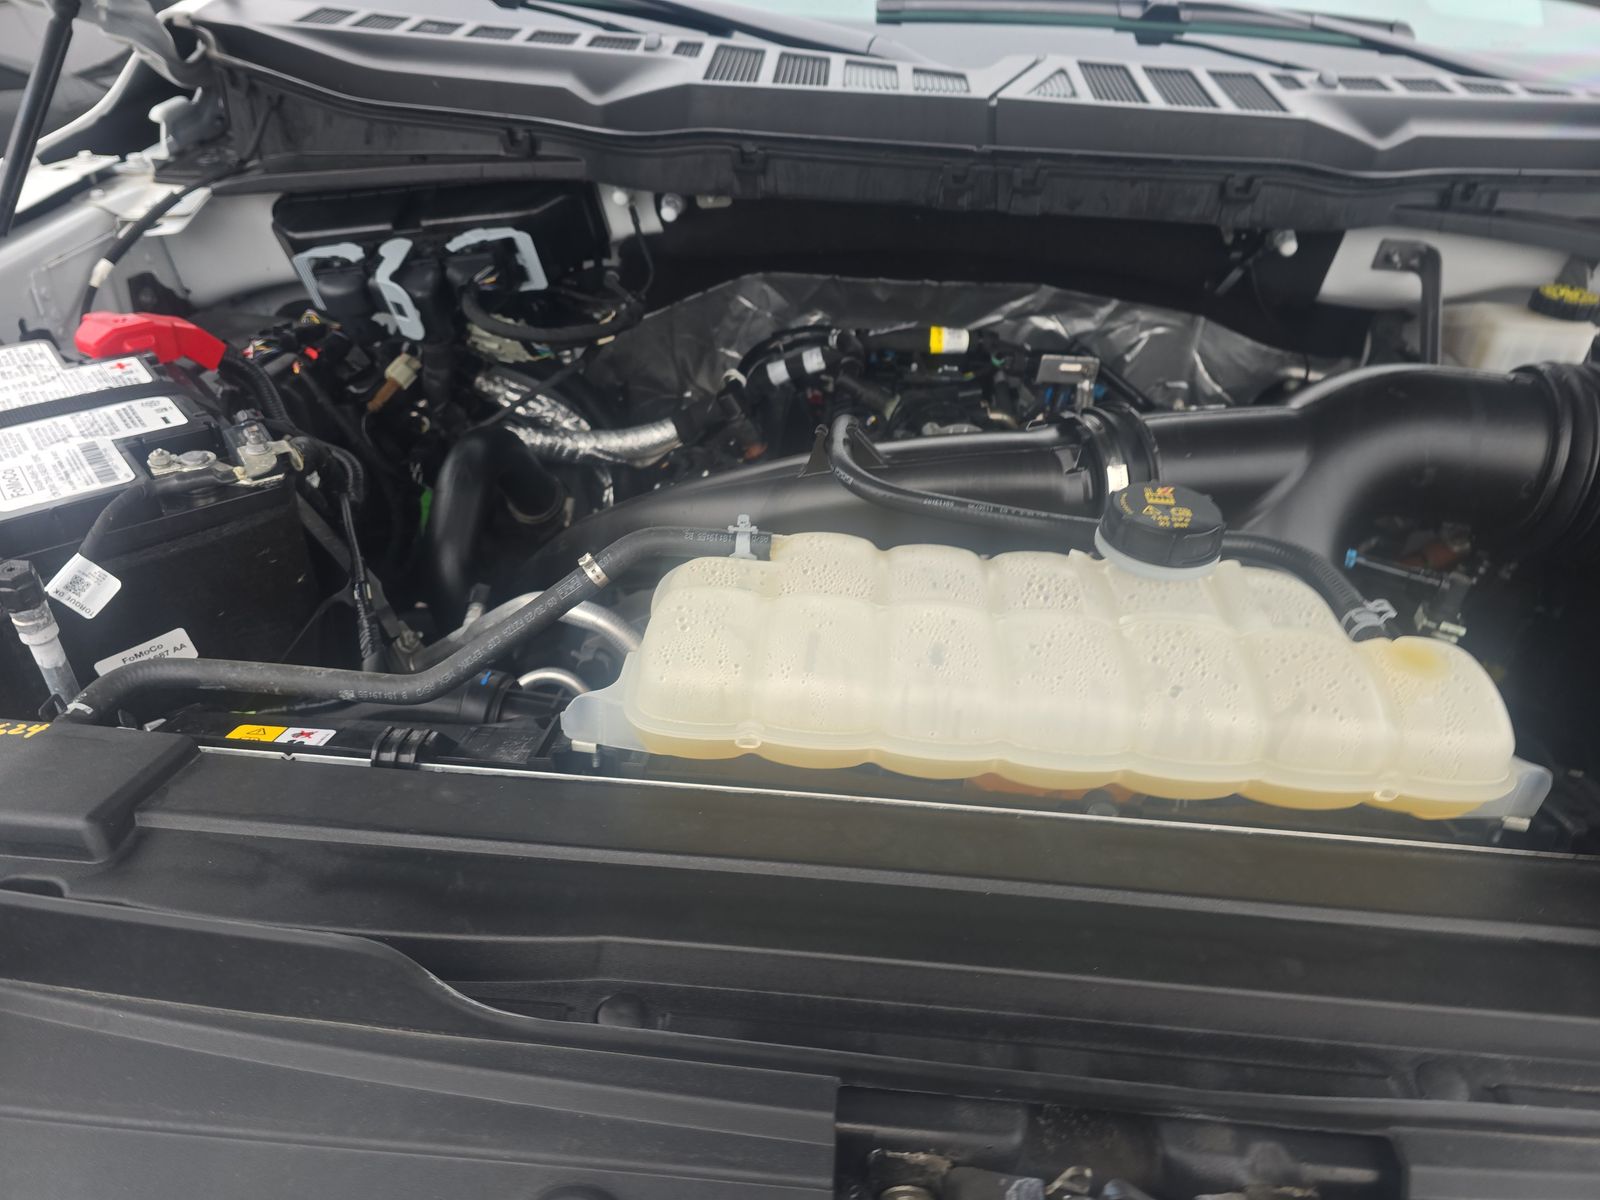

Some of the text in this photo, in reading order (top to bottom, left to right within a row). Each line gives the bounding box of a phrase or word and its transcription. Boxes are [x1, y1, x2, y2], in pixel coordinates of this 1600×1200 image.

[67, 596, 95, 617] TORQUE
[121, 643, 164, 664] FoMoCo
[173, 643, 187, 653] AA
